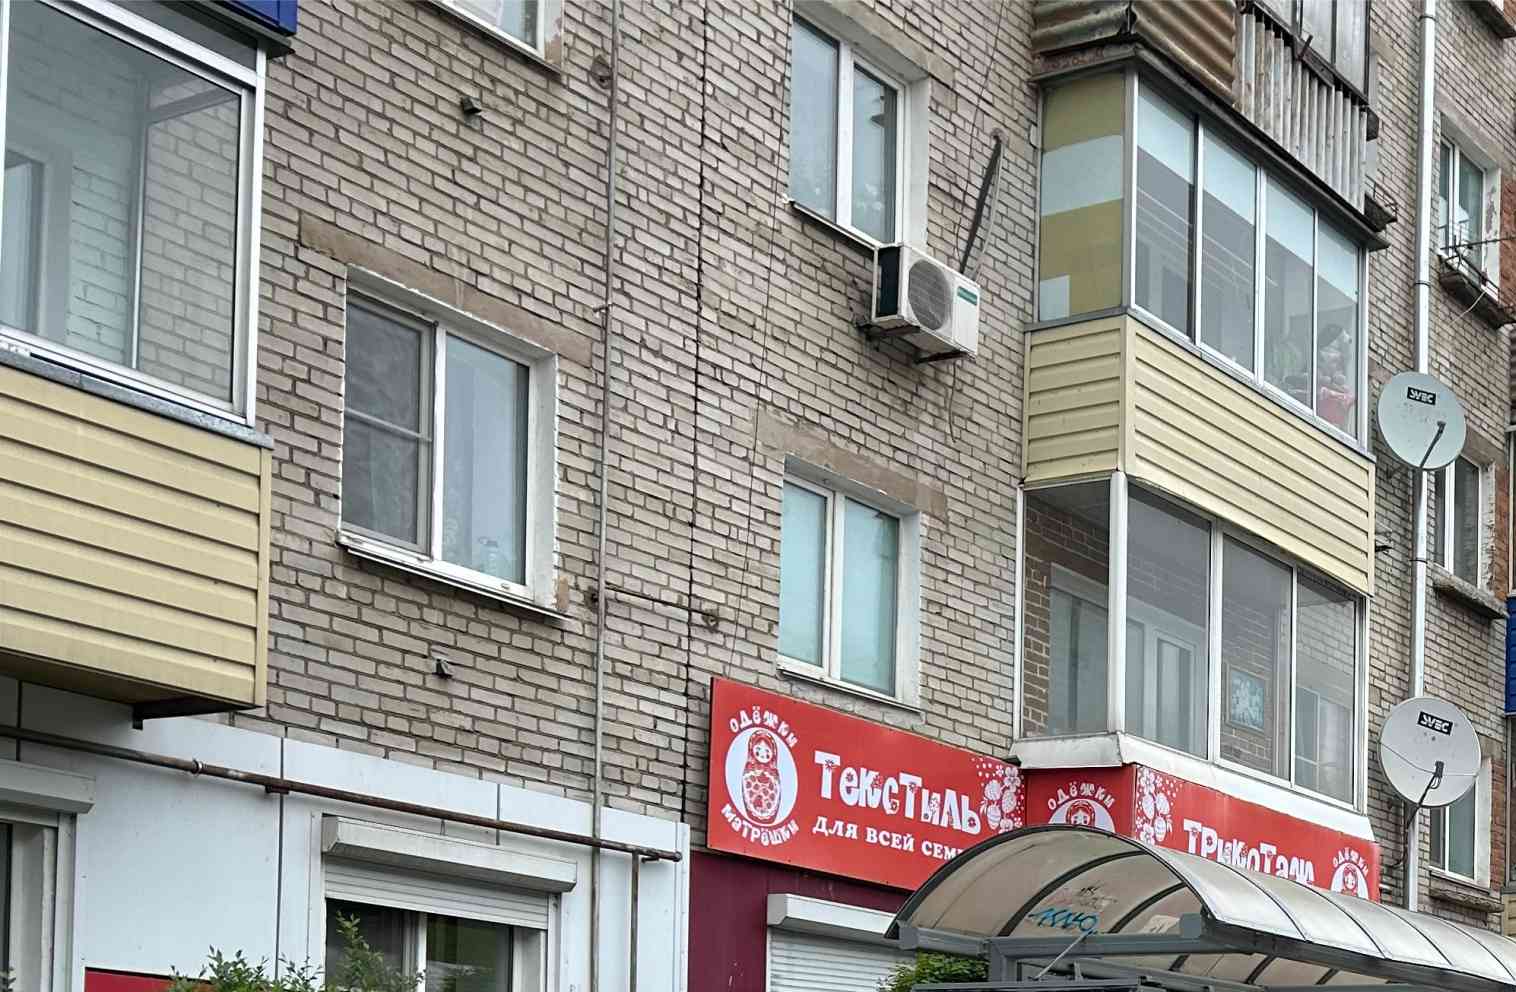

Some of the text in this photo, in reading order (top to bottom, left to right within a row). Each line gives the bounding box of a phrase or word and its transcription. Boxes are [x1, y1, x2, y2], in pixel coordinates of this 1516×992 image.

[1420, 713, 1450, 733] SVEC
[812, 816, 963, 860] ДЛЯ ВСЕЙ СЕМ
